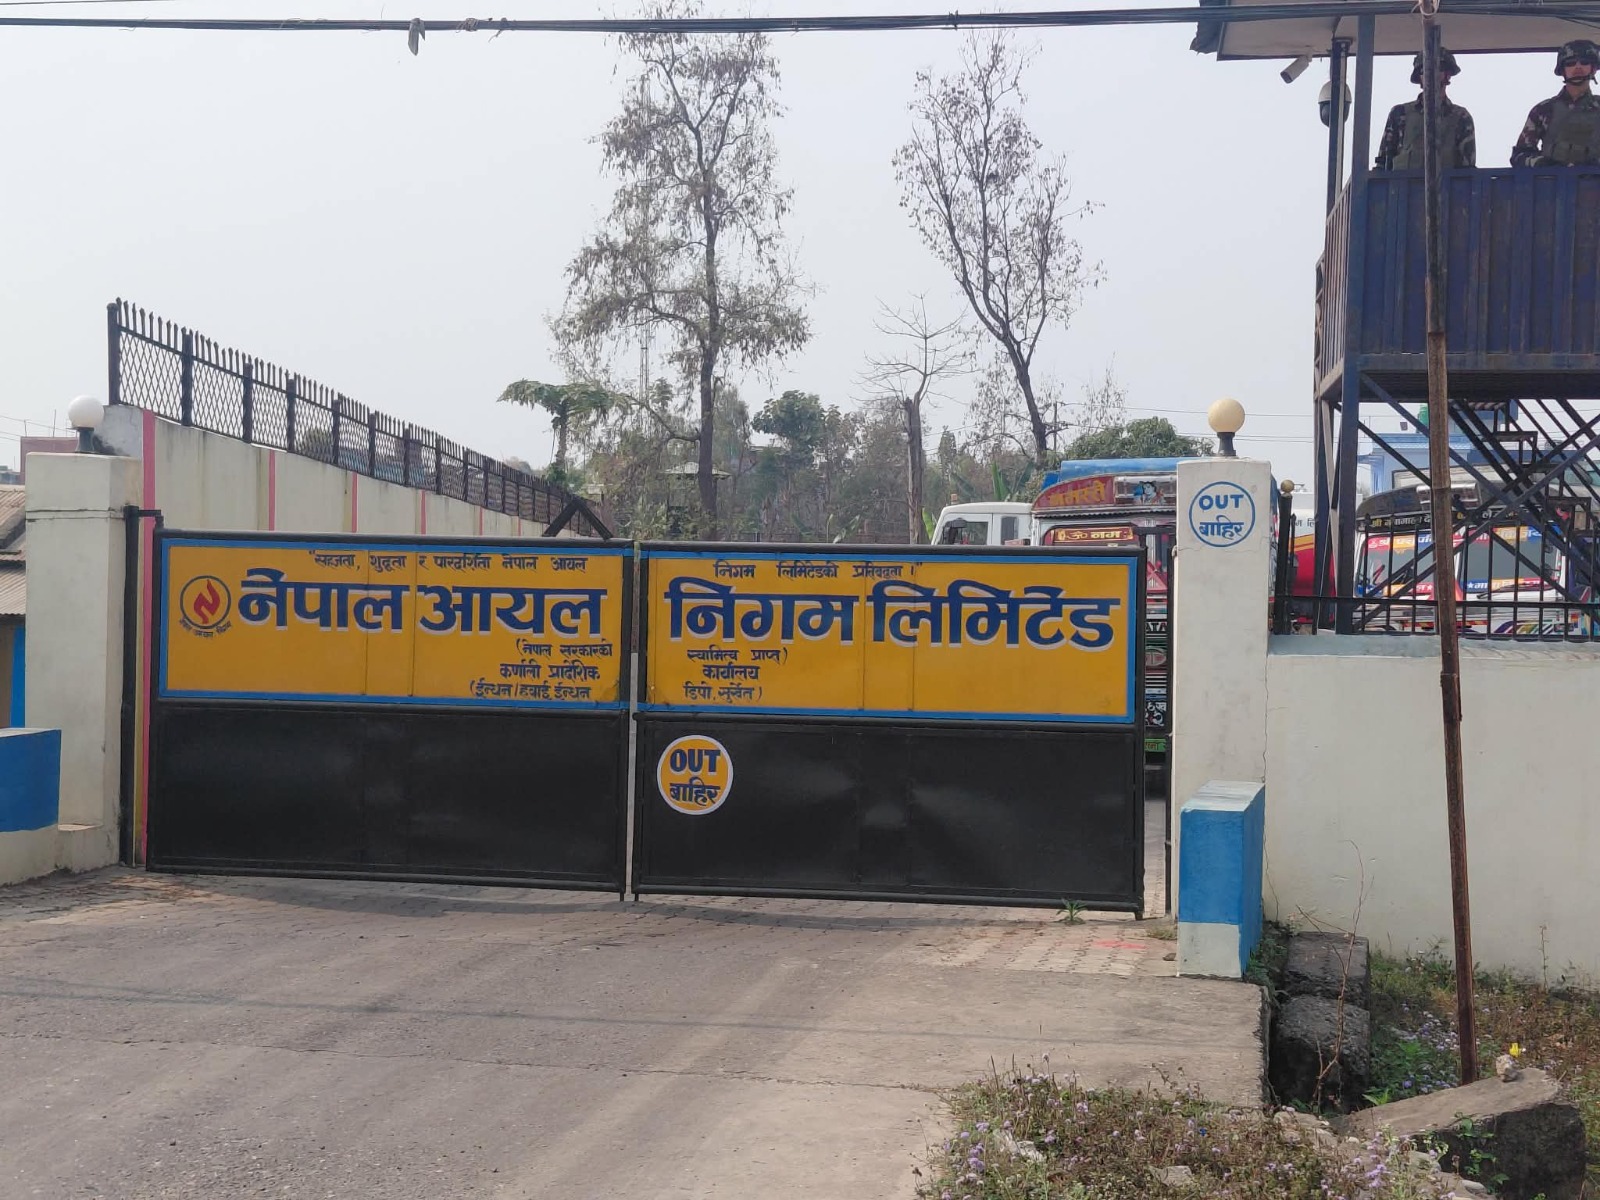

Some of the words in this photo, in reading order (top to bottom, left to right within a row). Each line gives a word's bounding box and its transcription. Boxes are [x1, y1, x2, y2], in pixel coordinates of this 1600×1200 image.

[1198, 494, 1244, 511] OUT
[1198, 514, 1245, 541] बाहिर
[502, 552, 538, 572] नेपाल
[551, 556, 588, 573] आयल
[713, 558, 756, 579] निगम
[238, 567, 410, 633] नेपाल
[416, 584, 608, 638] आयल
[663, 576, 859, 645] निगम
[866, 579, 1121, 652] लिमिटेड
[560, 638, 613, 660] सरकारको
[686, 644, 740, 663] स्वामित्व
[500, 658, 541, 680] कर्णाली
[548, 659, 600, 683] प्रादेशिक
[702, 661, 760, 681] कार्यालय
[670, 748, 721, 775] OUT
[669, 776, 721, 806] बाहिर
